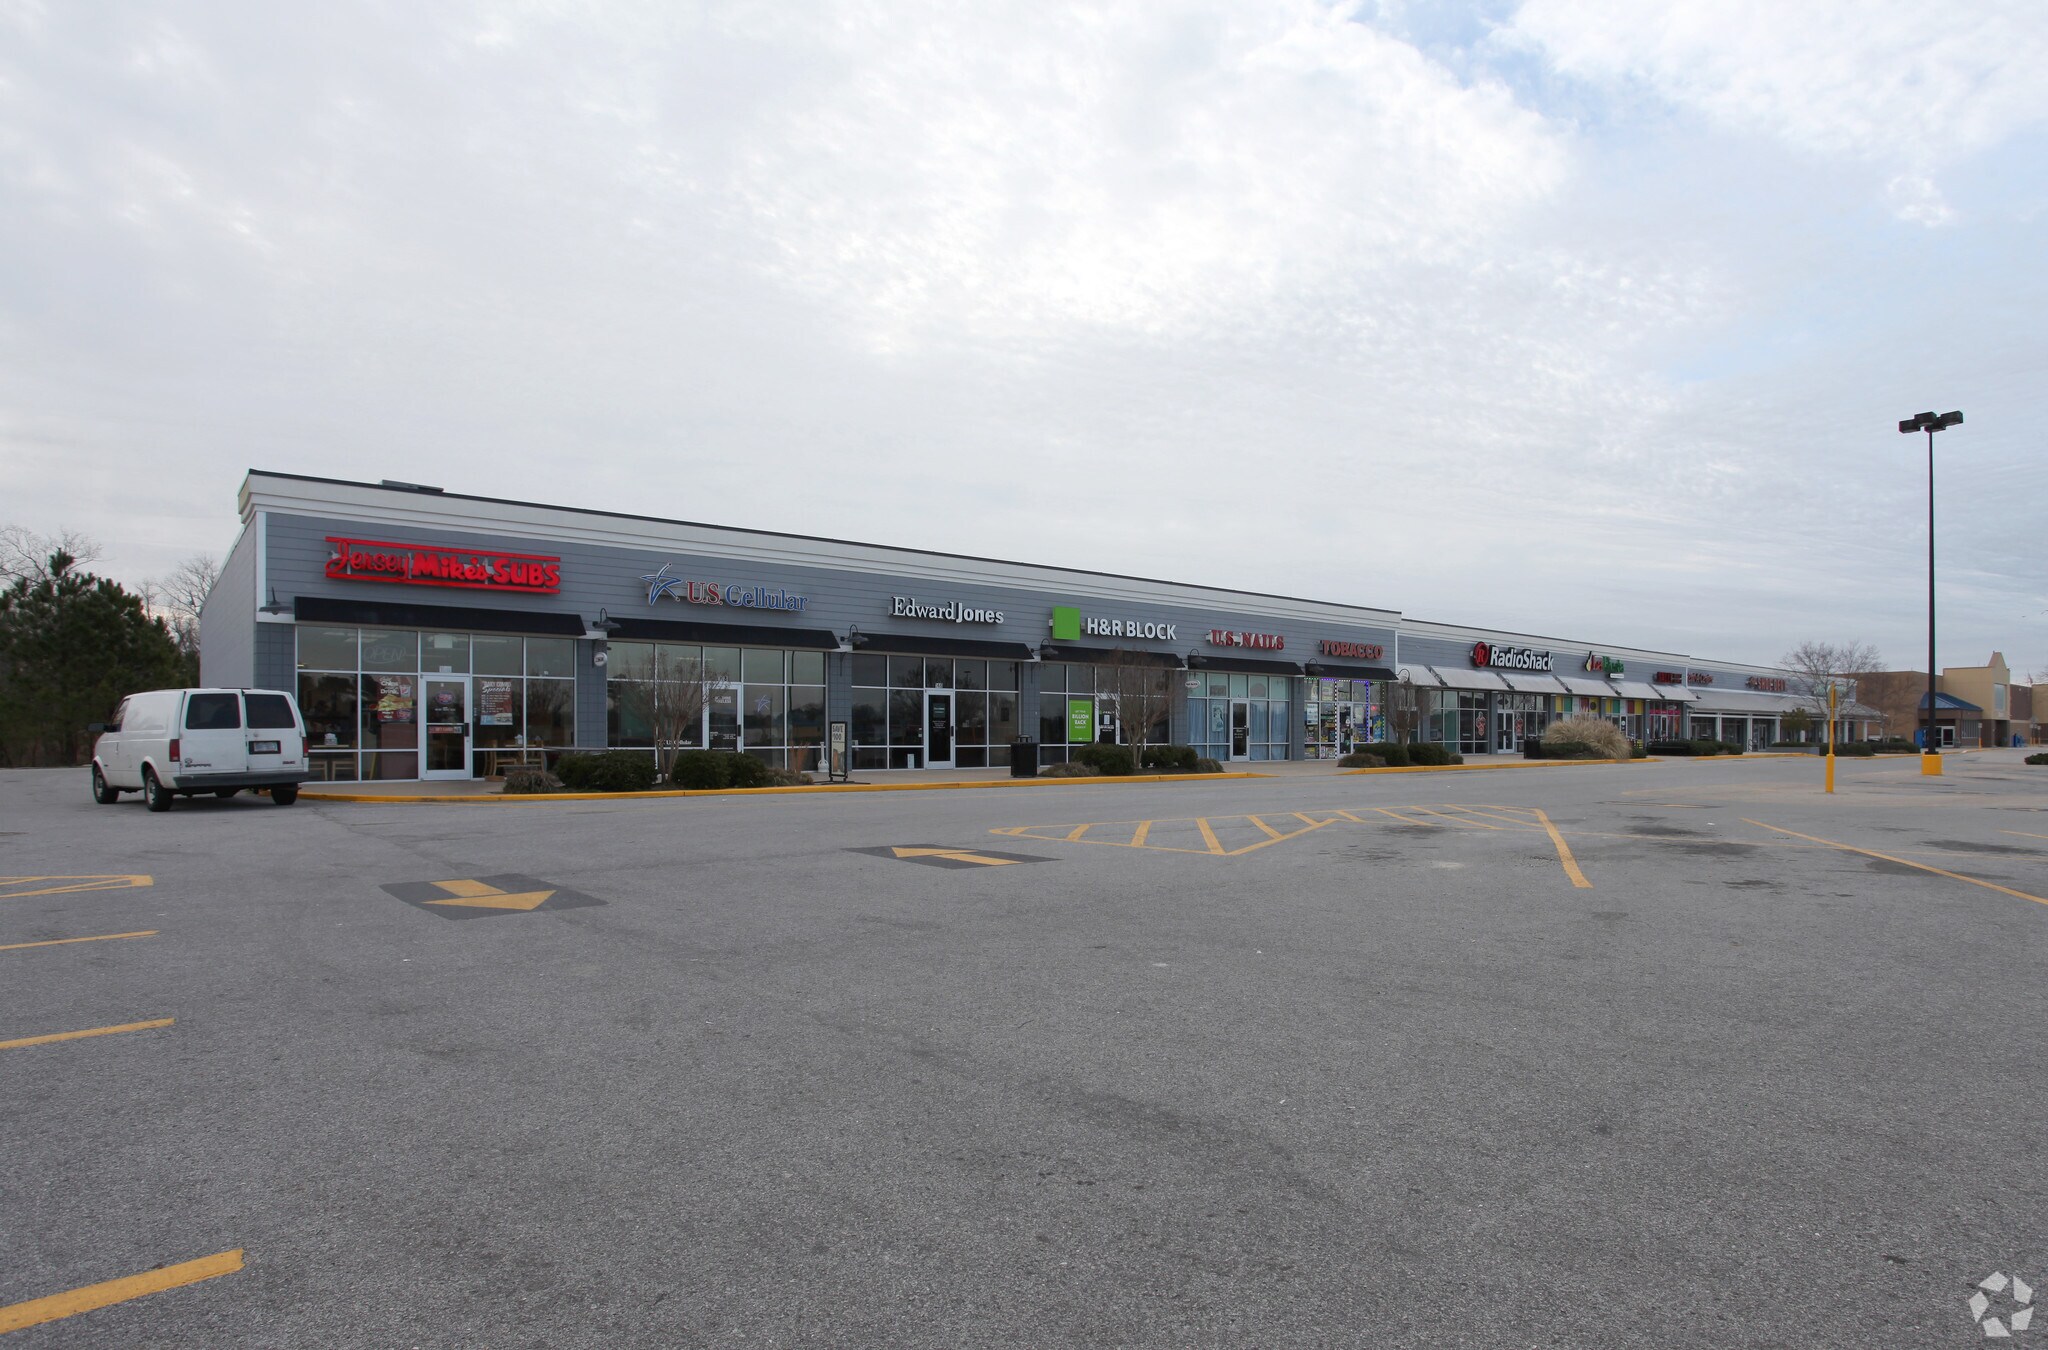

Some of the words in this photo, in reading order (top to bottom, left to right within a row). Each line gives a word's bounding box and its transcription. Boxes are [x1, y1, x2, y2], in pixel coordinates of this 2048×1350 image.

[325, 540, 410, 579] Jersey
[412, 552, 490, 581] Mike's
[493, 559, 561, 587] SUBS
[686, 580, 723, 606] U.S.
[725, 584, 808, 612] Cellular
[1087, 617, 1122, 636] H&R
[1126, 620, 1177, 640] BLOCK
[1210, 629, 1235, 647] U.S.
[1240, 631, 1285, 650] NAILS
[1320, 639, 1384, 659] TOBACCO
[1489, 646, 1554, 671] RadioShack
